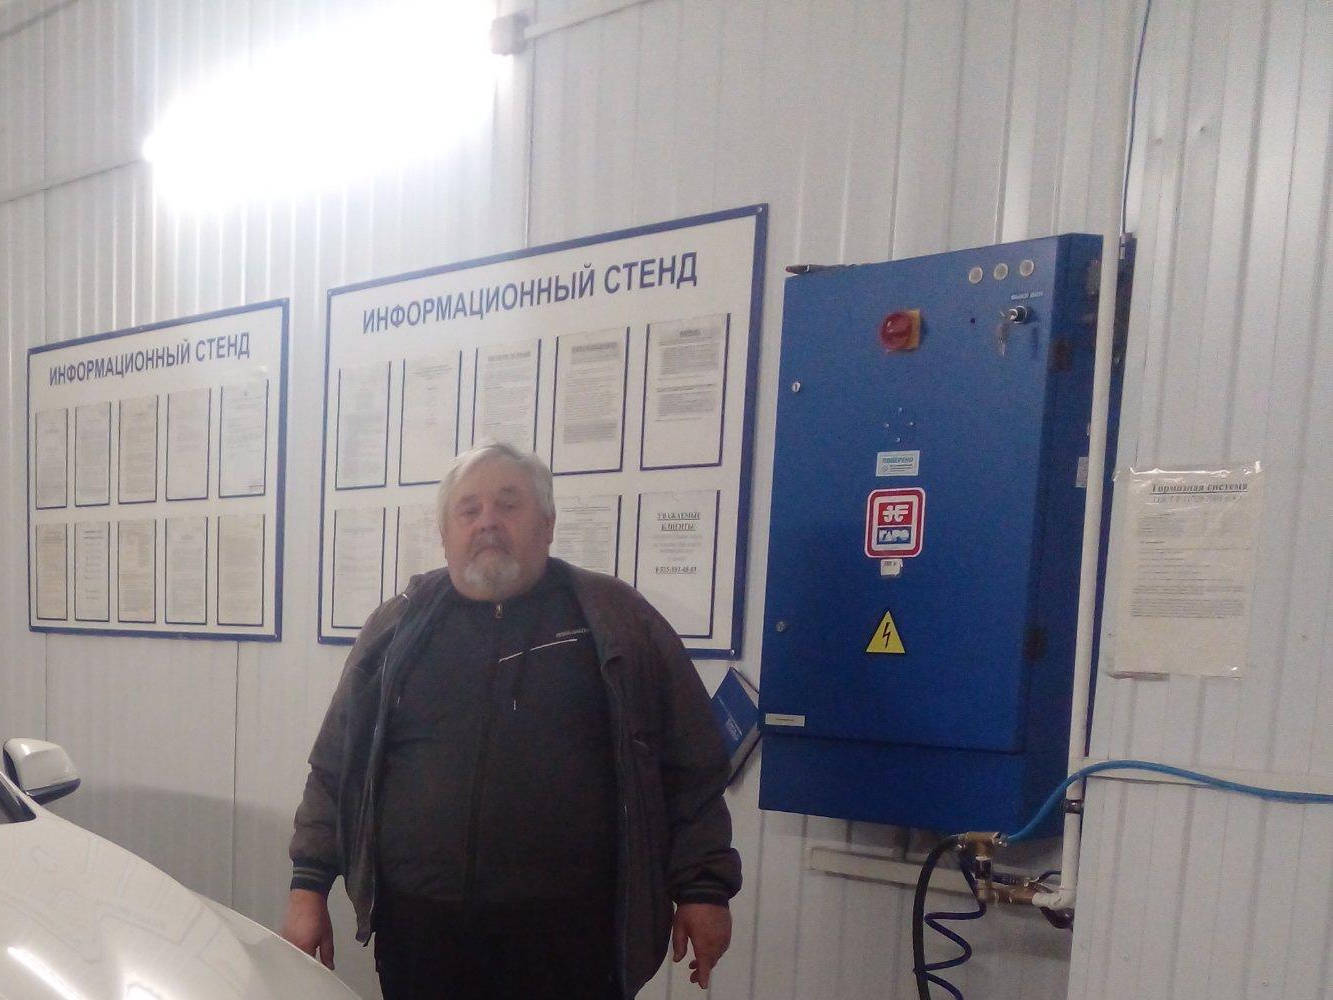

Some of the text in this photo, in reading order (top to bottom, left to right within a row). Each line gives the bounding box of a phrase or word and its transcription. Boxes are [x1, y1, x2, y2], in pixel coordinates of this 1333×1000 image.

[362, 251, 698, 335] ИНФОРМАЦИОННЫЙ СТЕНД
[48, 332, 251, 387] ИНФОРМАЦИОННЫЙ СТЕНД
